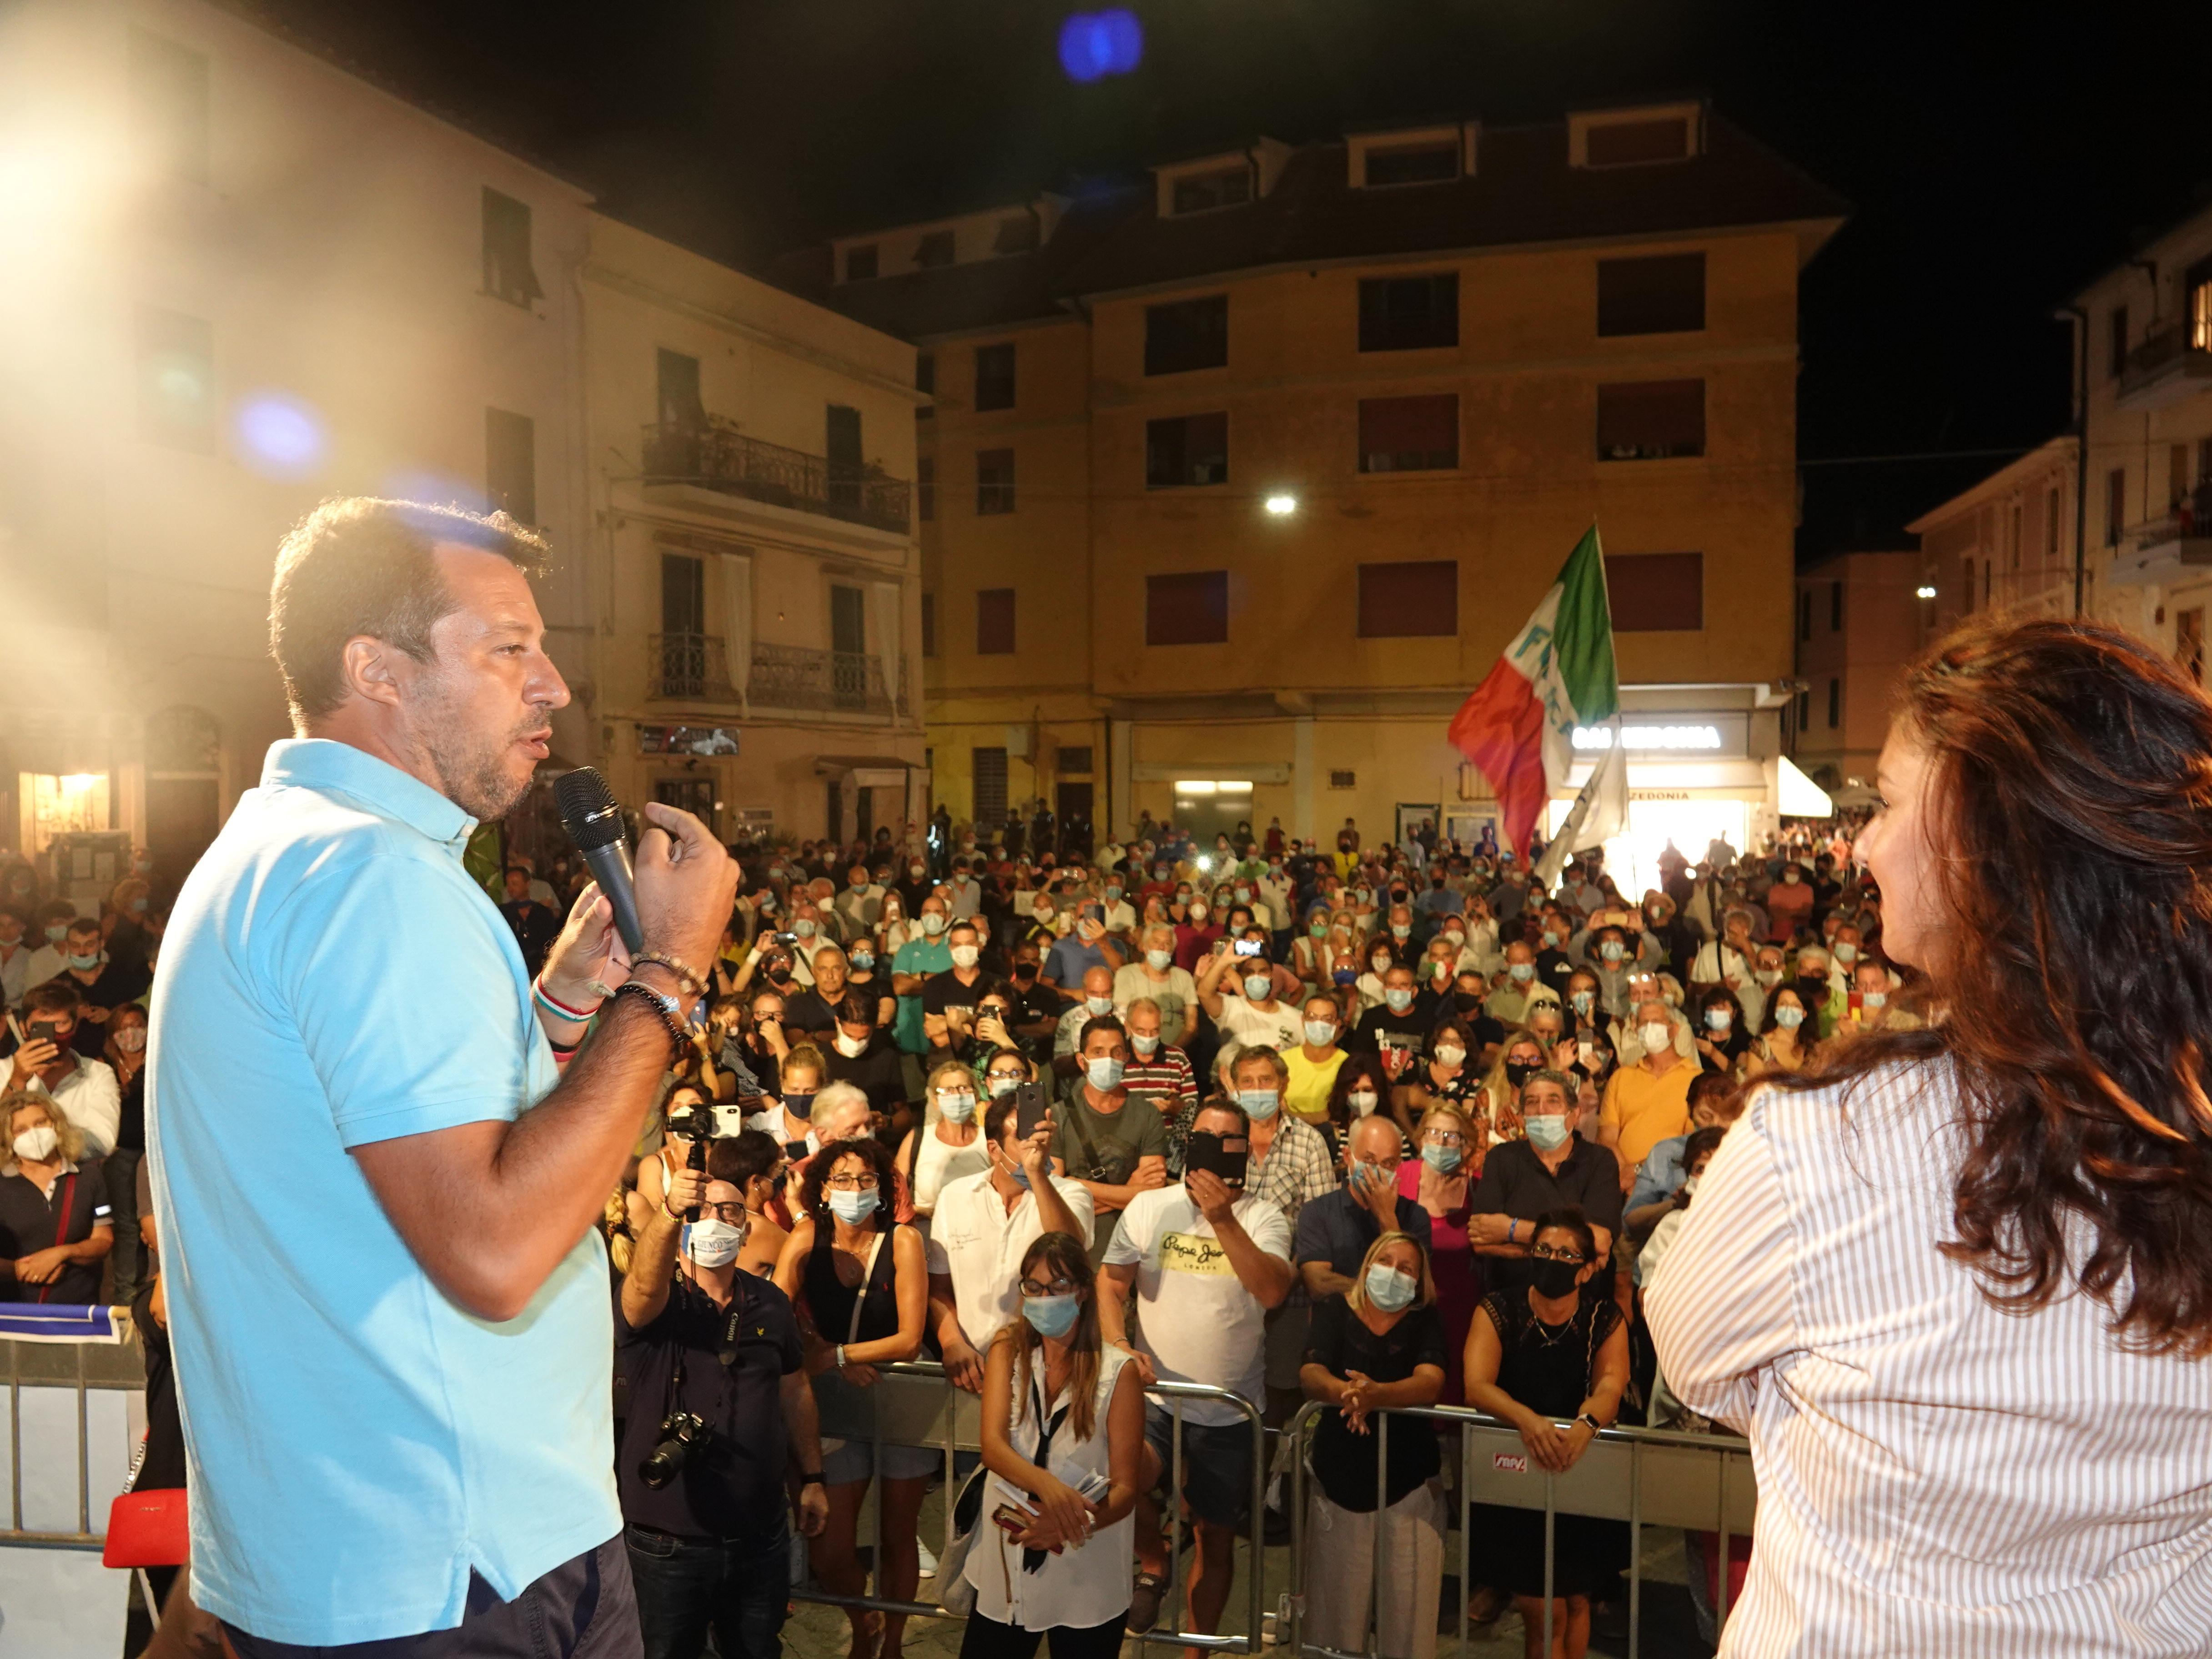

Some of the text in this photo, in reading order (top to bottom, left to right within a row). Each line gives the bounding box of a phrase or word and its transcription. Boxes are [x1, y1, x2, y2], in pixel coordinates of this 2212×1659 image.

[1163, 1236, 1225, 1263] Pepe Jea
[726, 1312, 739, 1341] Canon
